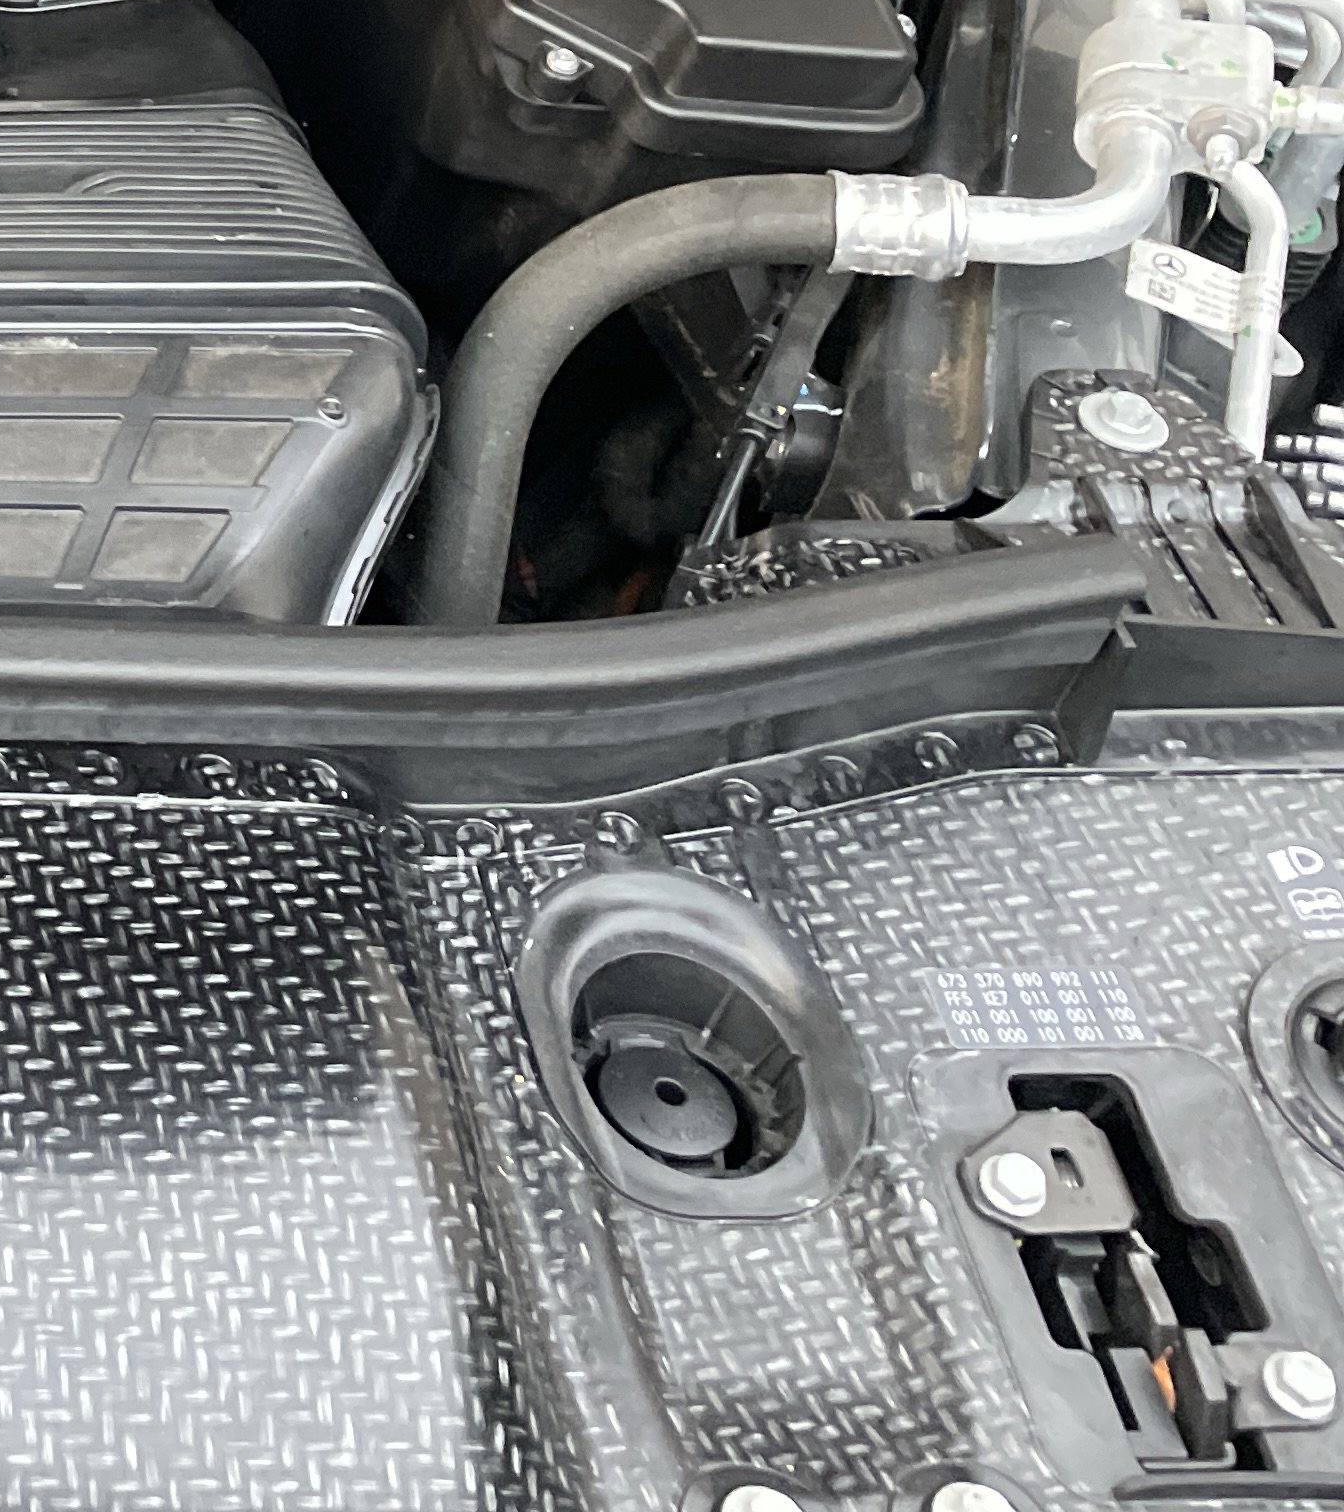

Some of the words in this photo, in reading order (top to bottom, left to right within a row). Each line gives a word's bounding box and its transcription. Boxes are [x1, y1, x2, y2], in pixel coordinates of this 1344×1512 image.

[1089, 971, 1119, 985] 111
[1020, 990, 1050, 1006] 011
[1057, 989, 1088, 1004] 001
[951, 1010, 981, 1025] 001
[990, 1009, 1019, 1024] 001
[1029, 1008, 1059, 1024] 100
[1066, 1008, 1096, 1023] 001
[960, 1028, 990, 1043] 110
[997, 1027, 1028, 1043] 000
[1037, 1026, 1066, 1042] 101
[1073, 1025, 1104, 1041] 001
